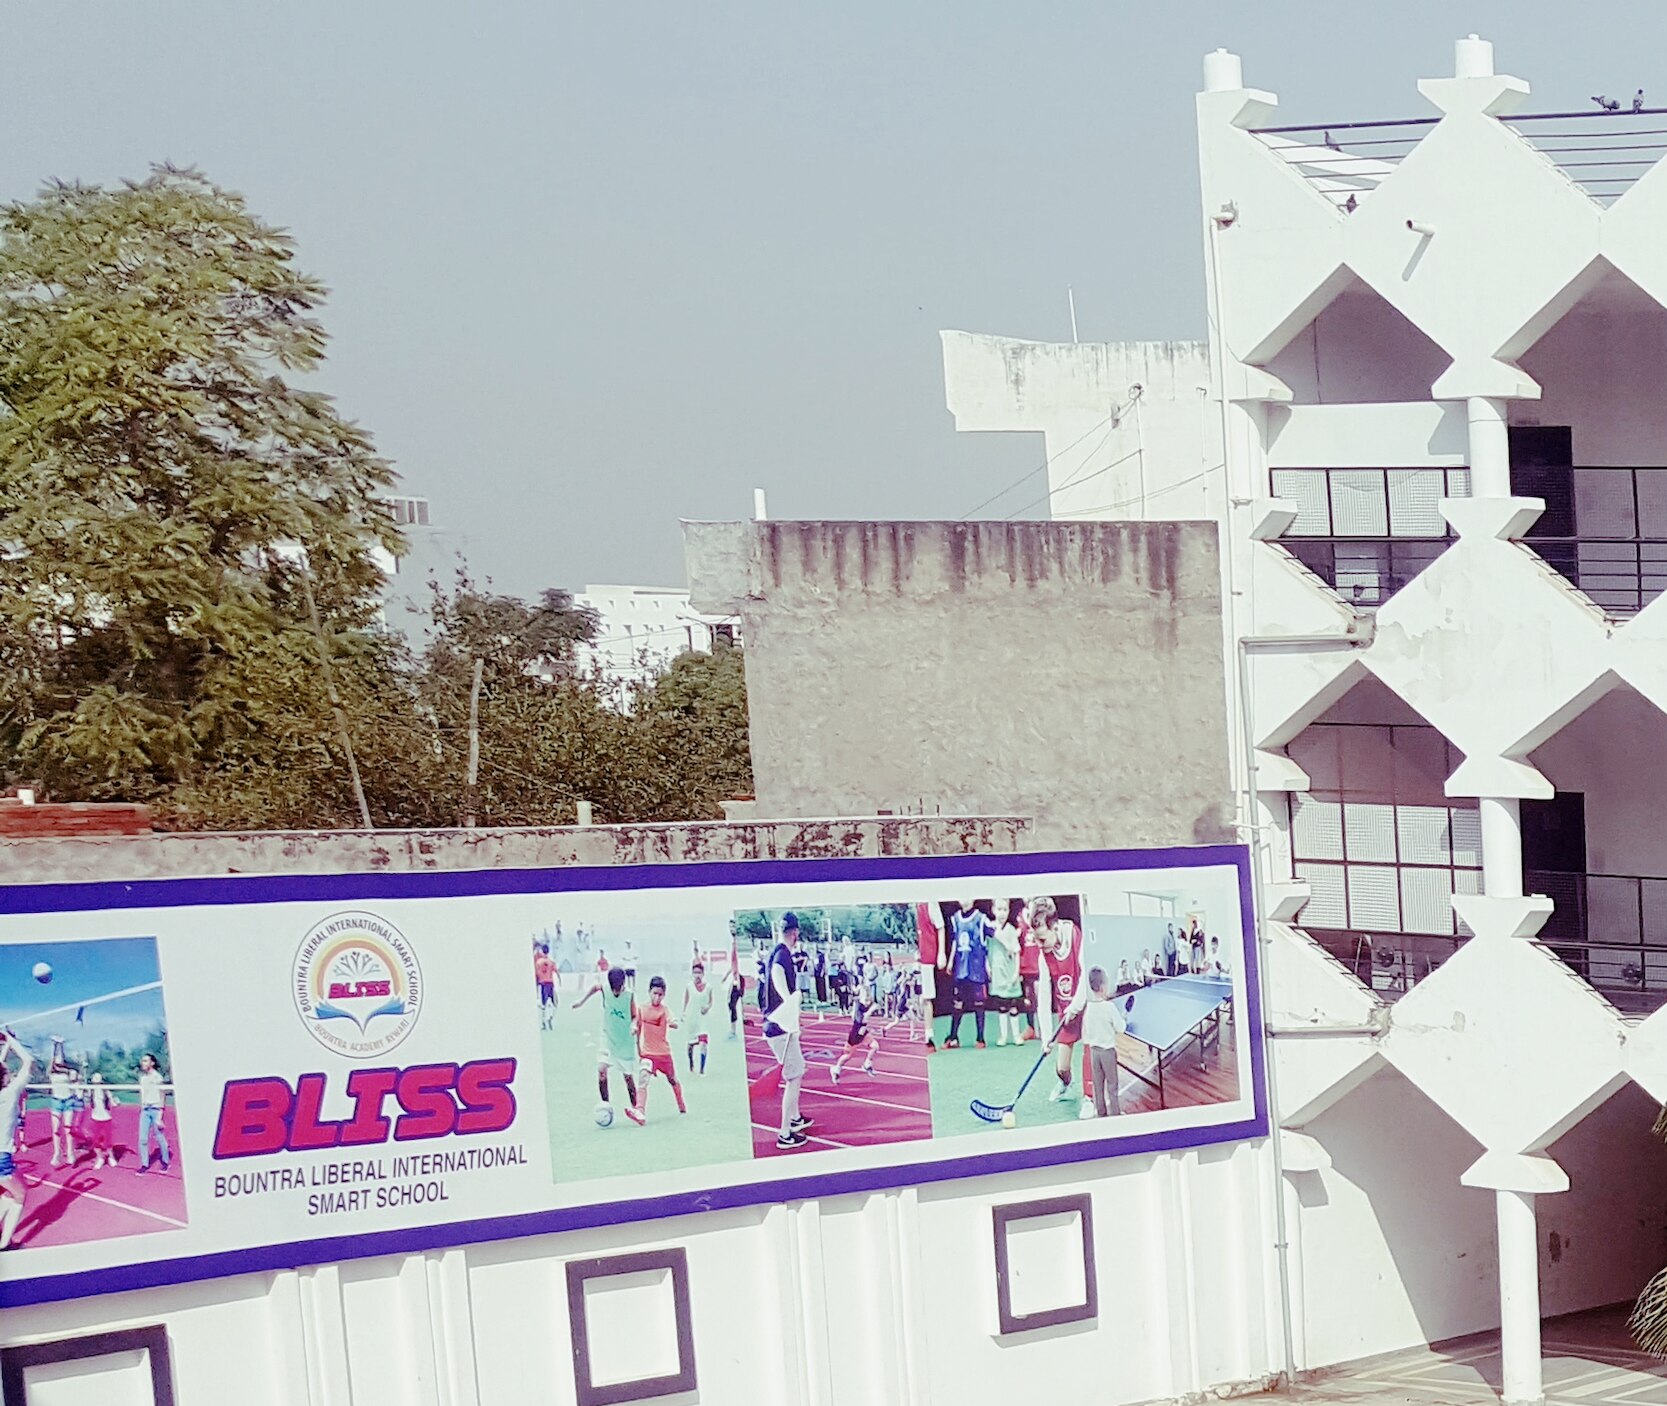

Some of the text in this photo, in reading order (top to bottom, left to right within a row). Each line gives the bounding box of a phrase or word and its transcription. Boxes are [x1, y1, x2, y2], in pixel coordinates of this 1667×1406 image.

[298, 919, 418, 1012] BOUNTRA LIBERAL INTERNATIONAL SMART SCHOOL
[328, 980, 391, 999] BLISS
[212, 1057, 517, 1160] BLISS
[214, 1145, 528, 1198] BOUNTRA LIBERAL INTERNATIONAL
[307, 1181, 449, 1216] SMART SCHOOL
